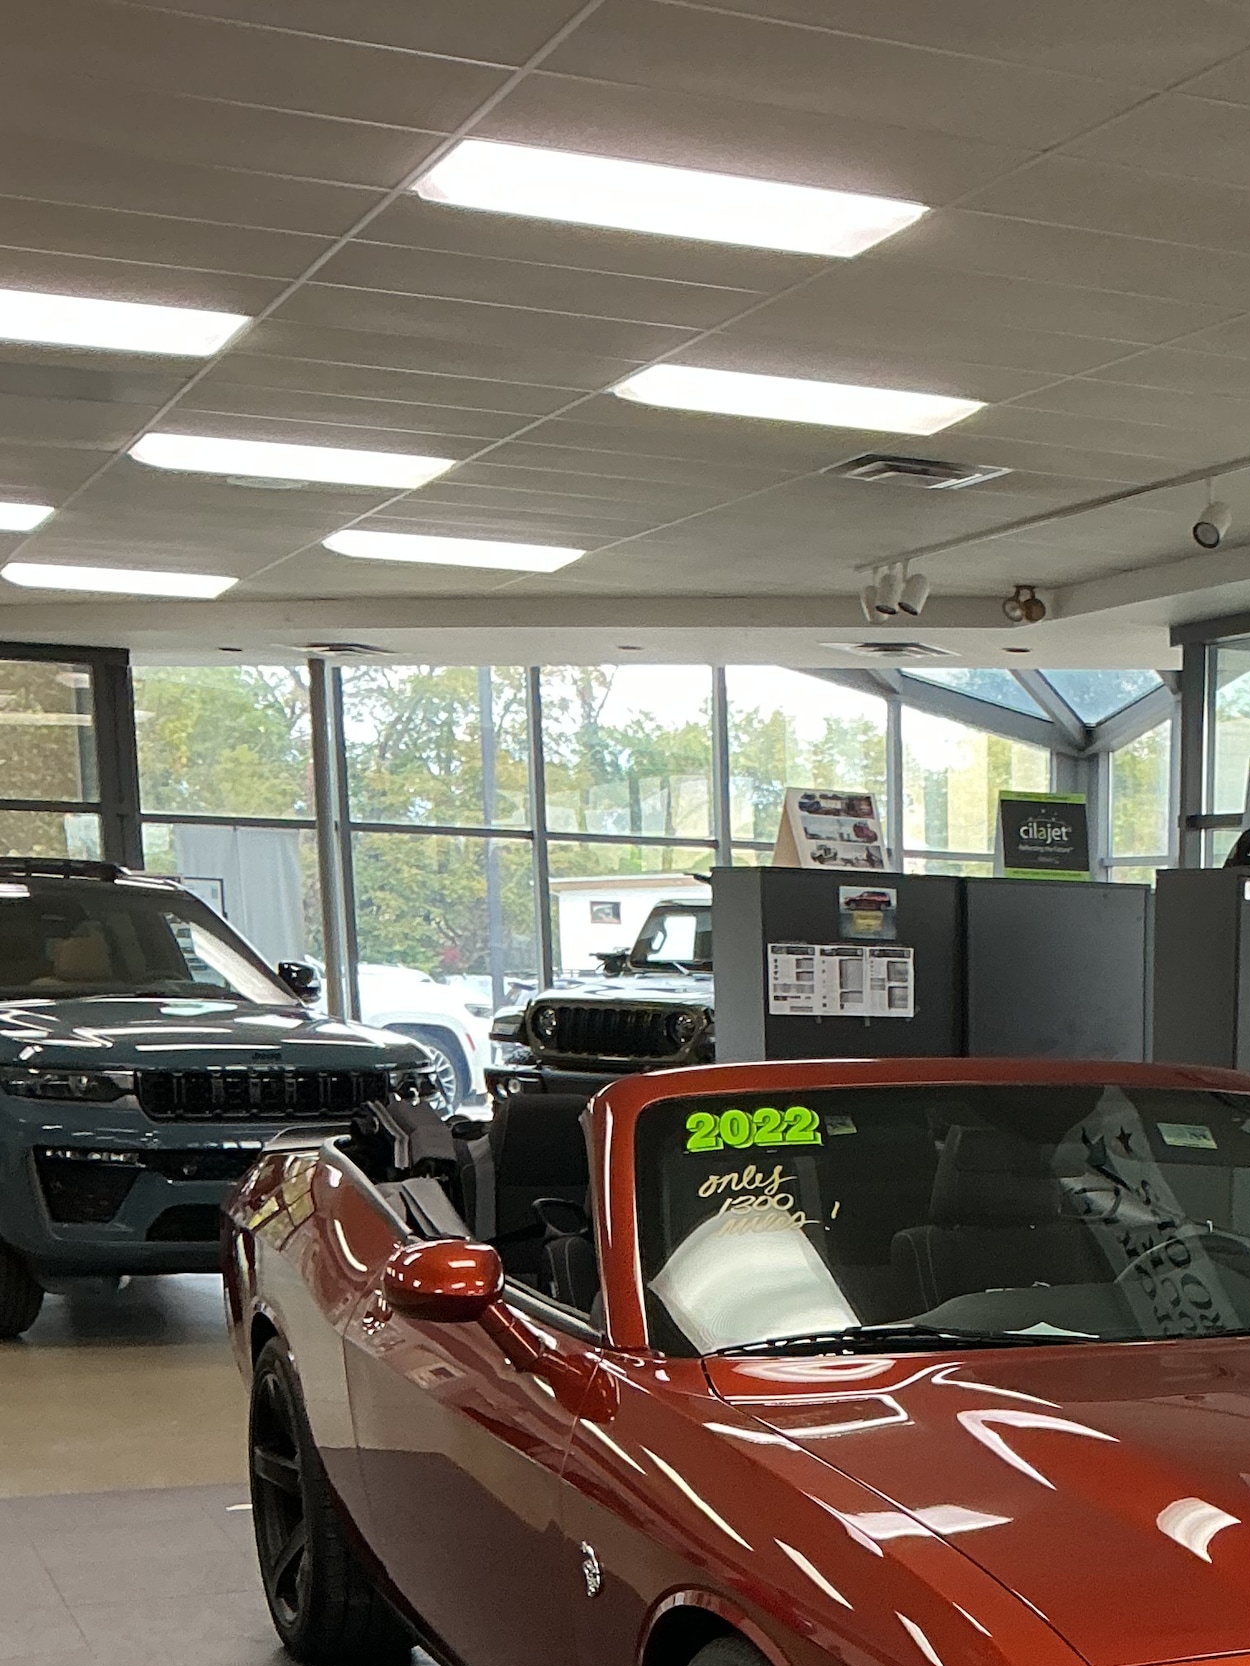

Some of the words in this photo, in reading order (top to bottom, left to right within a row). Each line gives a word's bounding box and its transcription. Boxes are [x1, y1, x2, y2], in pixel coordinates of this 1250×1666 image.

[1019, 821, 1069, 844] cilajet
[686, 1106, 823, 1152] 2022
[697, 1164, 798, 1198] only
